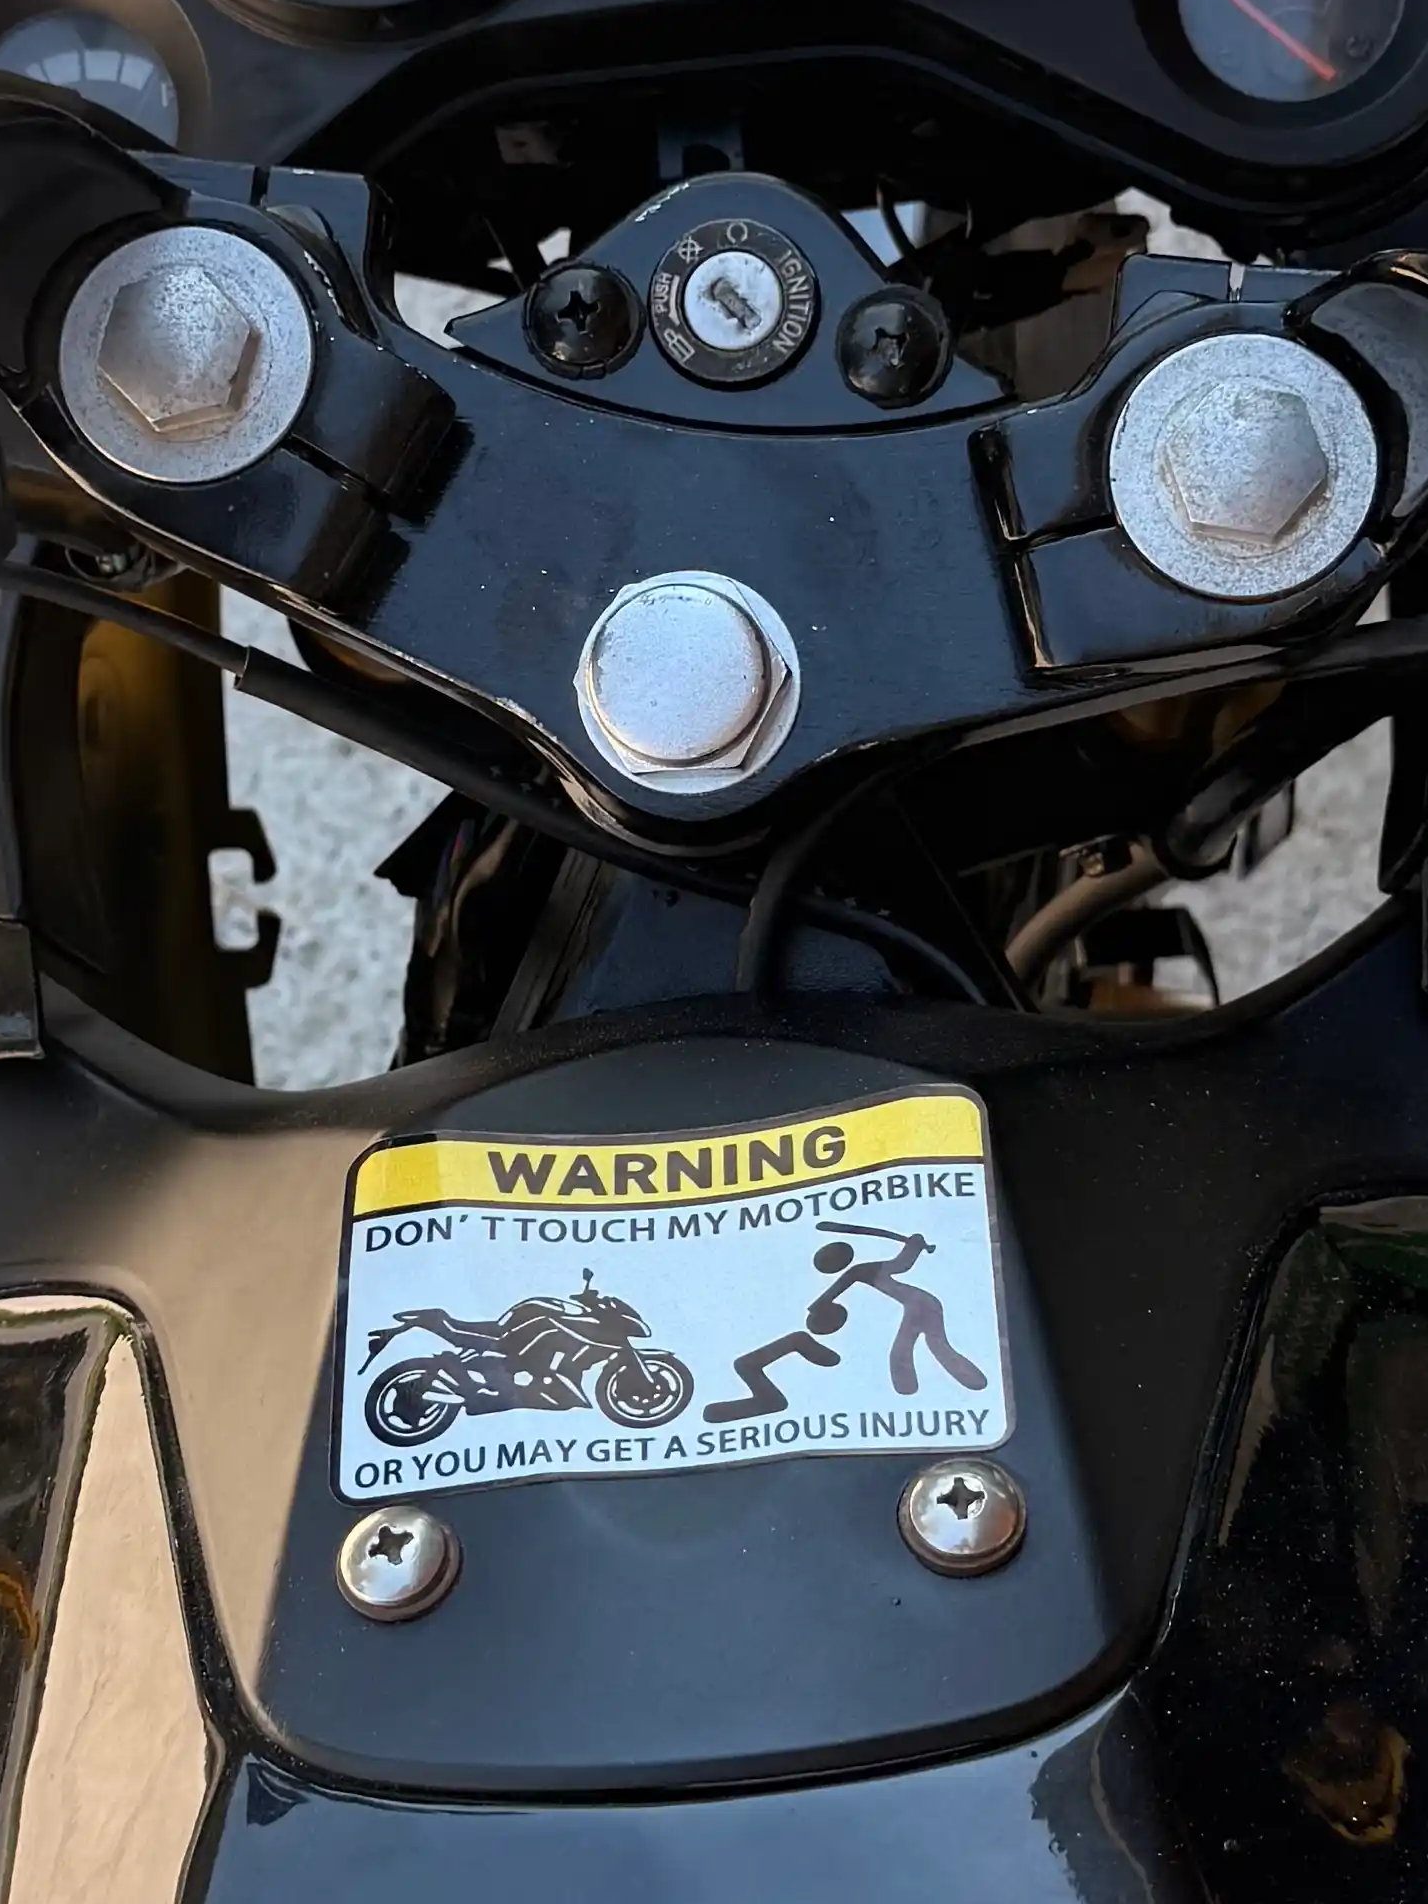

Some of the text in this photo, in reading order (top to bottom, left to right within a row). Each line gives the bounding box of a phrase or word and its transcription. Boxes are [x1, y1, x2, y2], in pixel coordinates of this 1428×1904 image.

[655, 273, 671, 313] PUSH
[772, 249, 810, 353] IGNITION
[488, 1125, 846, 1196] WARNING
[513, 1217, 654, 1243] TOUCH
[668, 1210, 728, 1240] MY
[739, 1172, 975, 1230] MOTORBIKE
[354, 1409, 989, 1488] OR YOU MAY GET A SERIOUS INJURY
